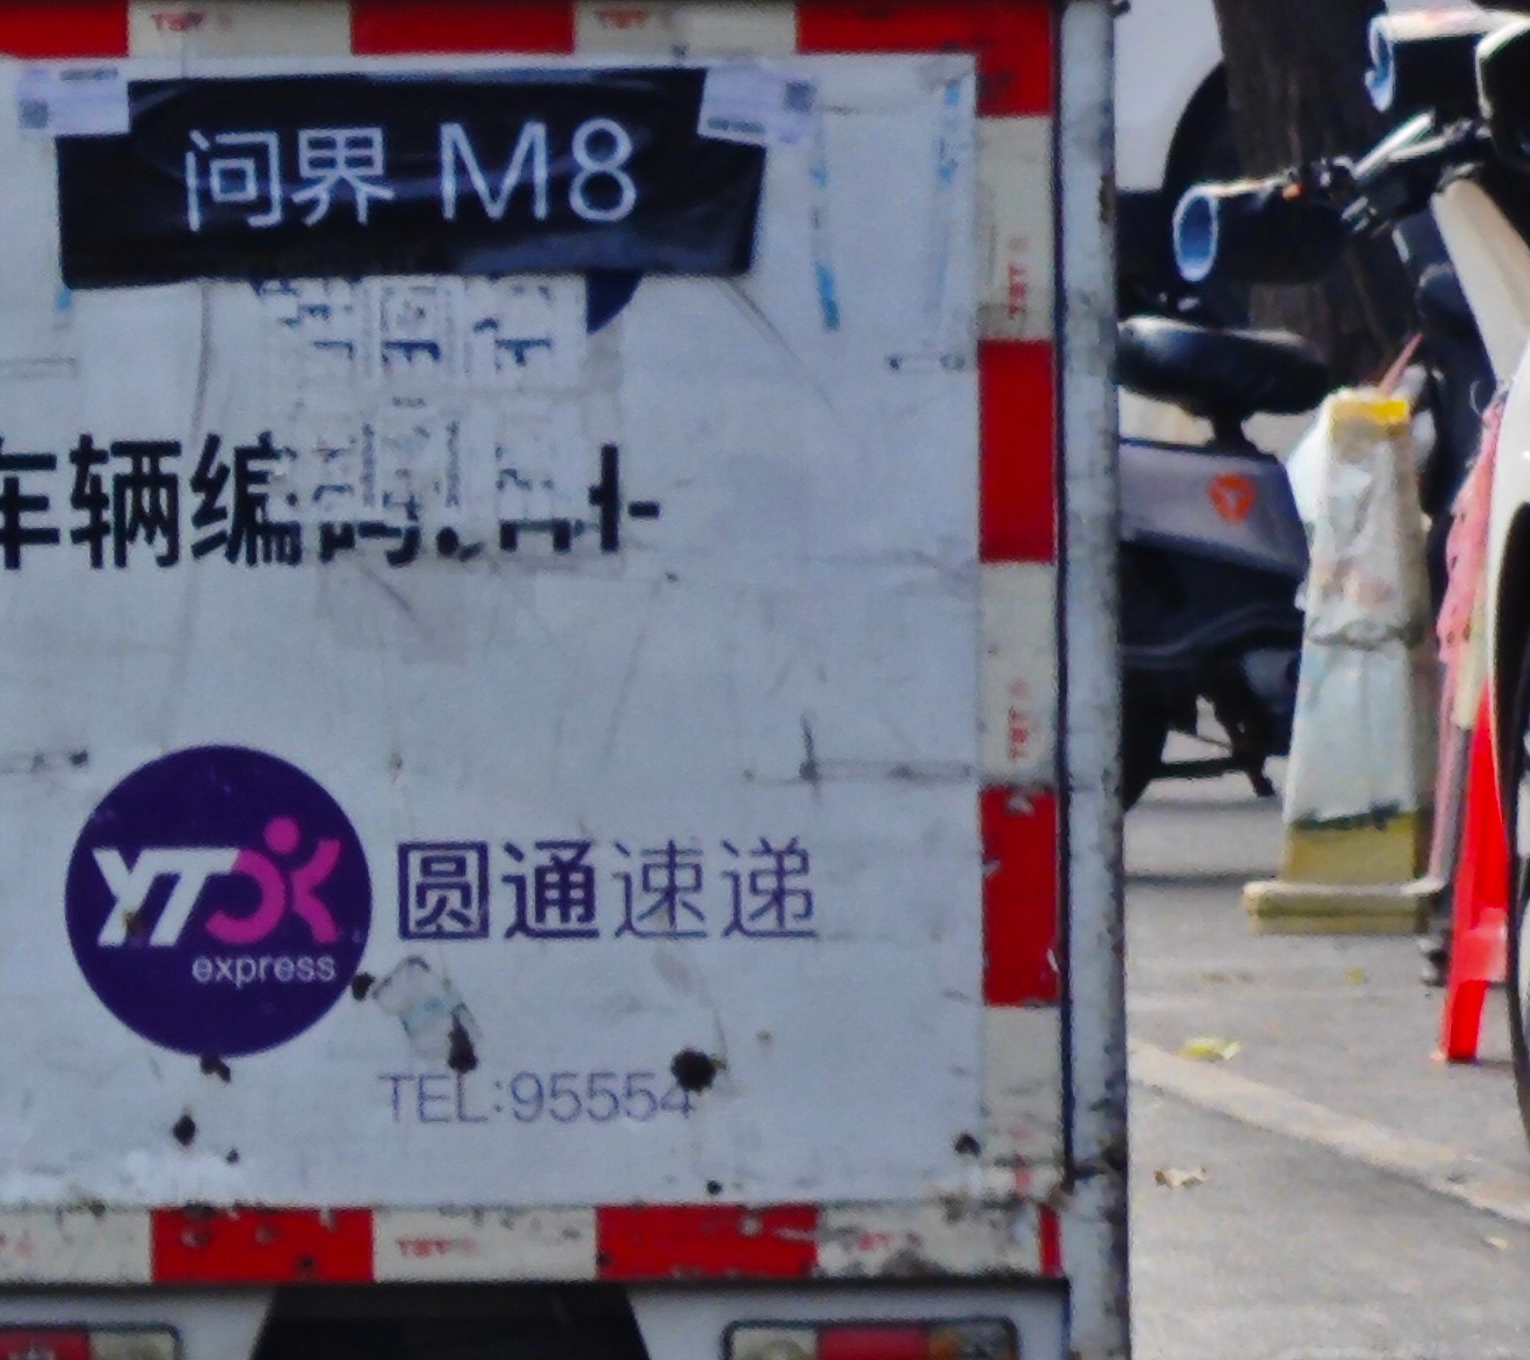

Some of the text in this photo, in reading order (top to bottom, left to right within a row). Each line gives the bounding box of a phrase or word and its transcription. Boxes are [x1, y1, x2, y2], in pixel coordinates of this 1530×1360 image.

[185, 118, 638, 232] 问界 M8
[397, 837, 820, 941] 圆通速递
[191, 954, 337, 988] express
